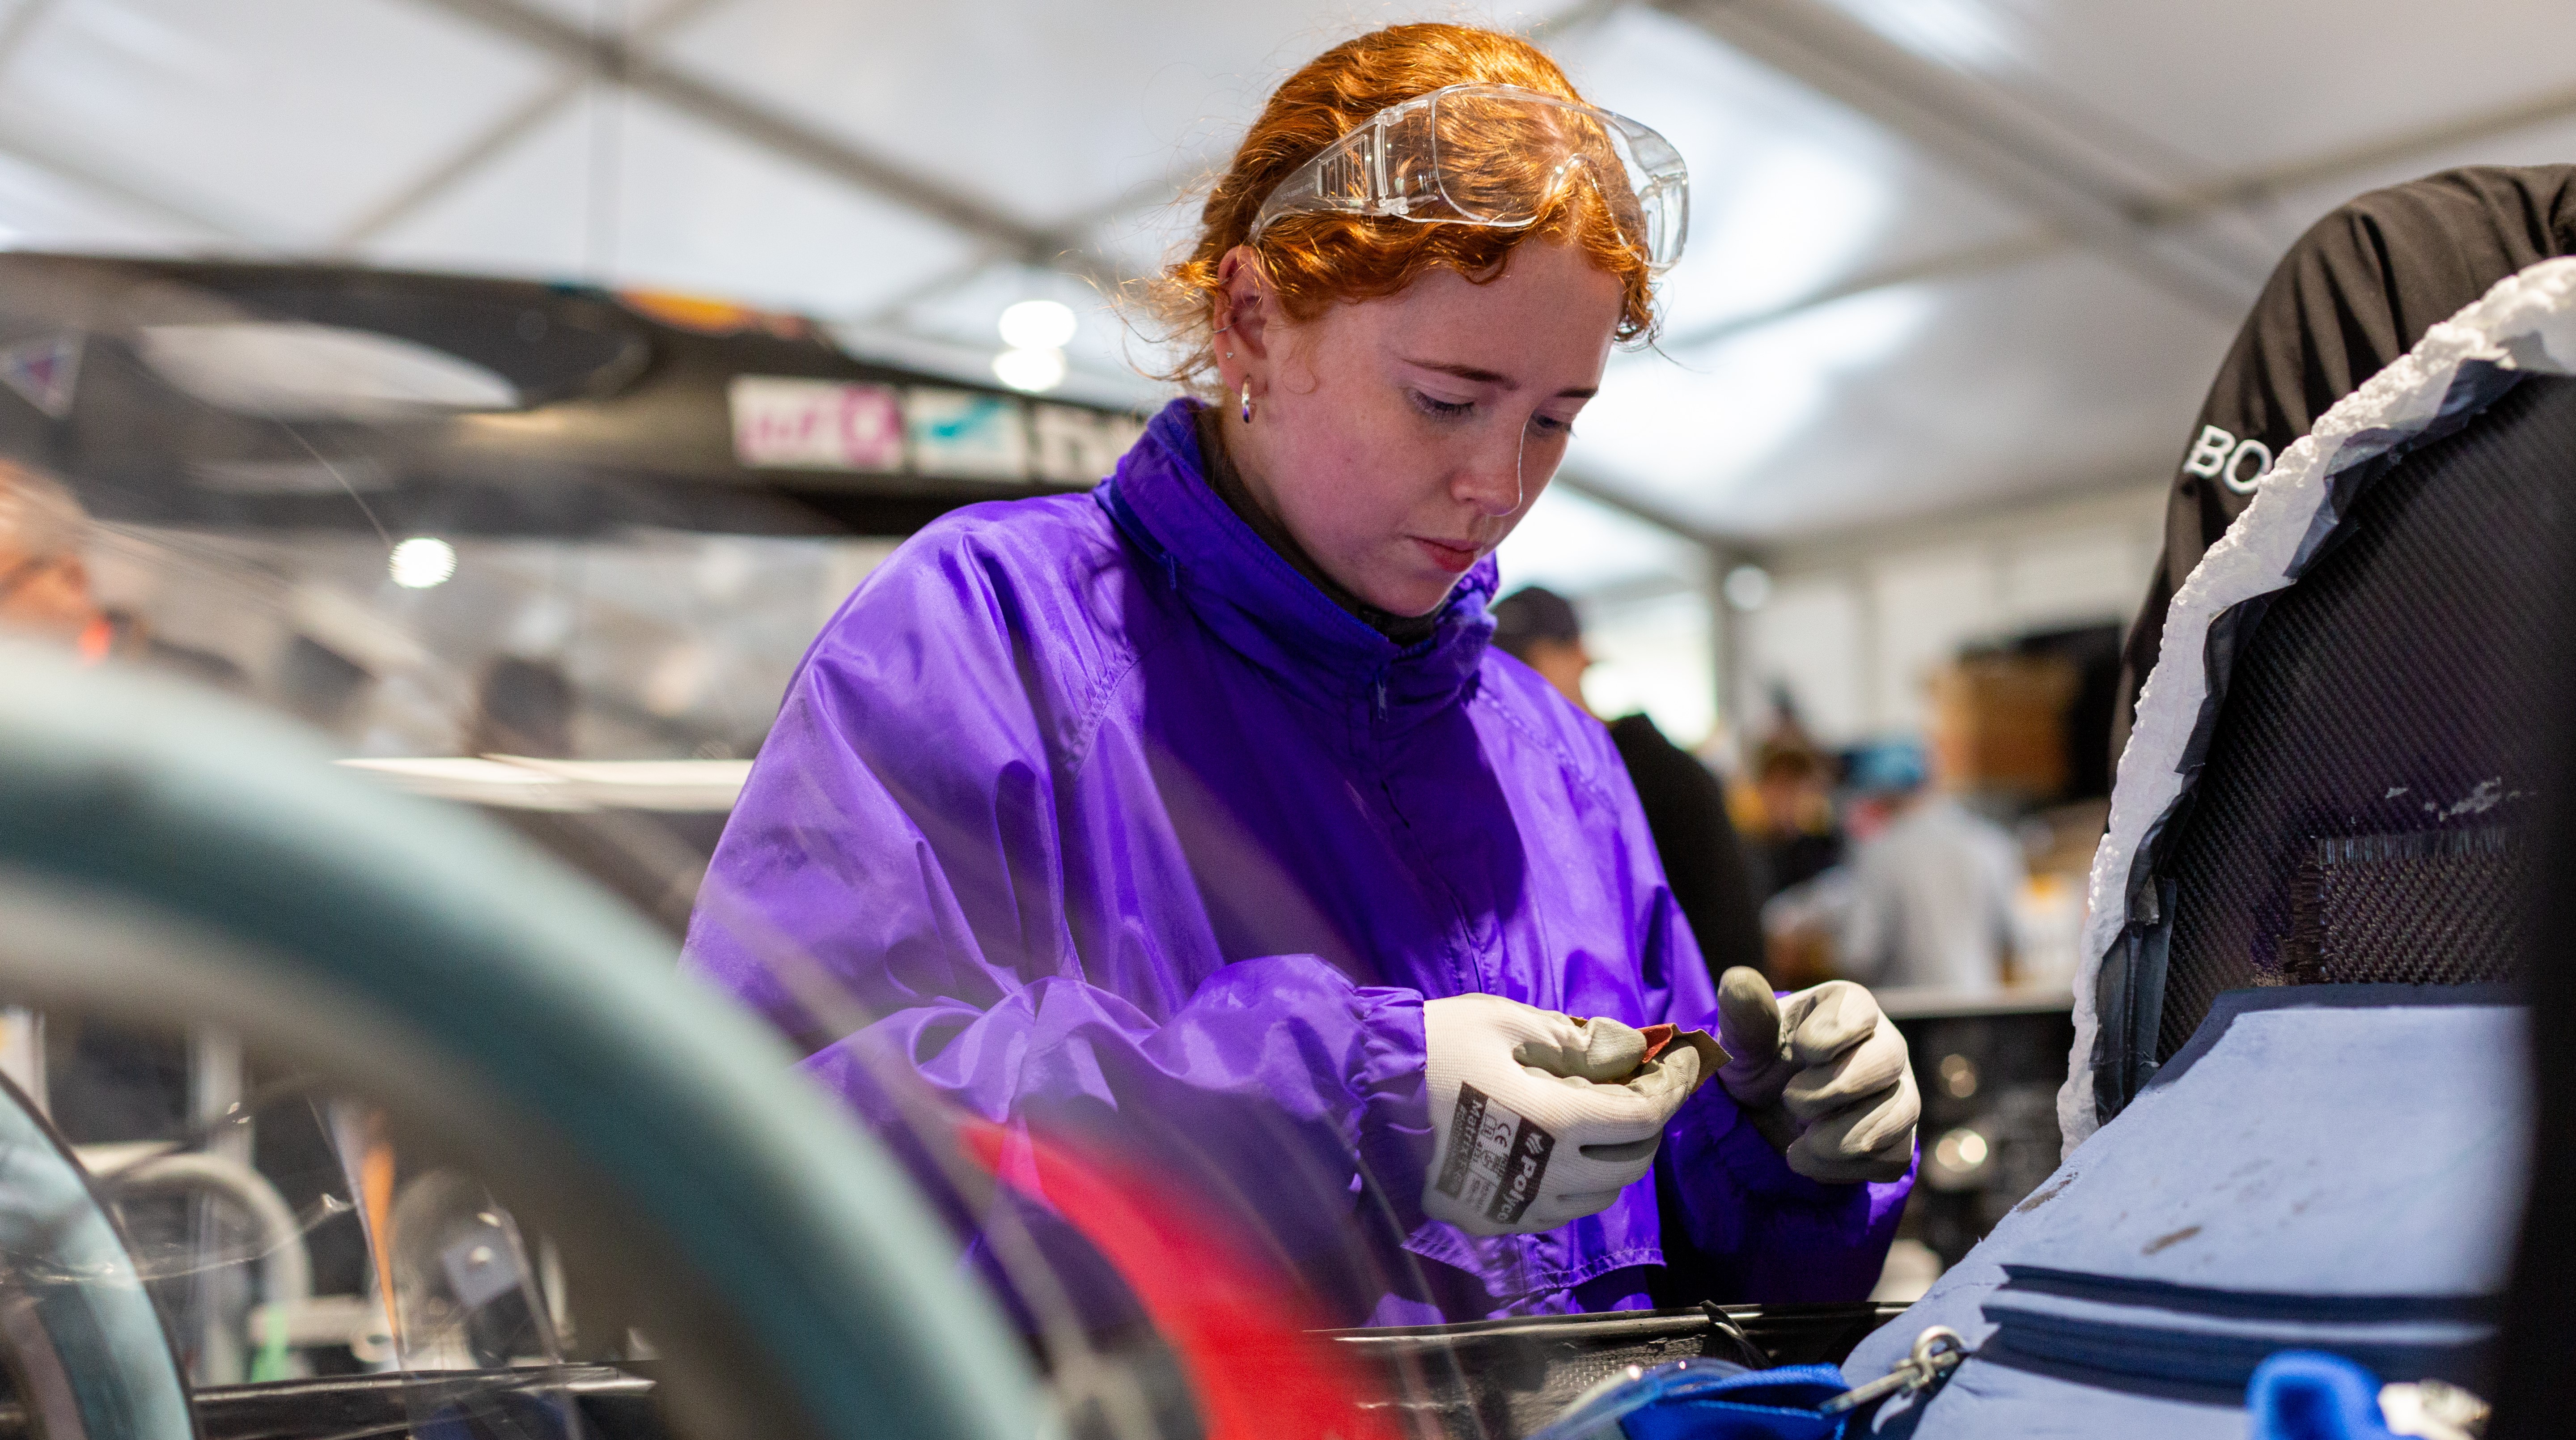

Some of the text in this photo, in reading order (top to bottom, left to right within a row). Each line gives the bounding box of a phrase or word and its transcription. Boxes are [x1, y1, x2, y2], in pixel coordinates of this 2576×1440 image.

[1461, 1099, 1483, 1154] Matrix
[1495, 1122, 1511, 1148] CE
[1497, 1155, 1537, 1220] Polyco
